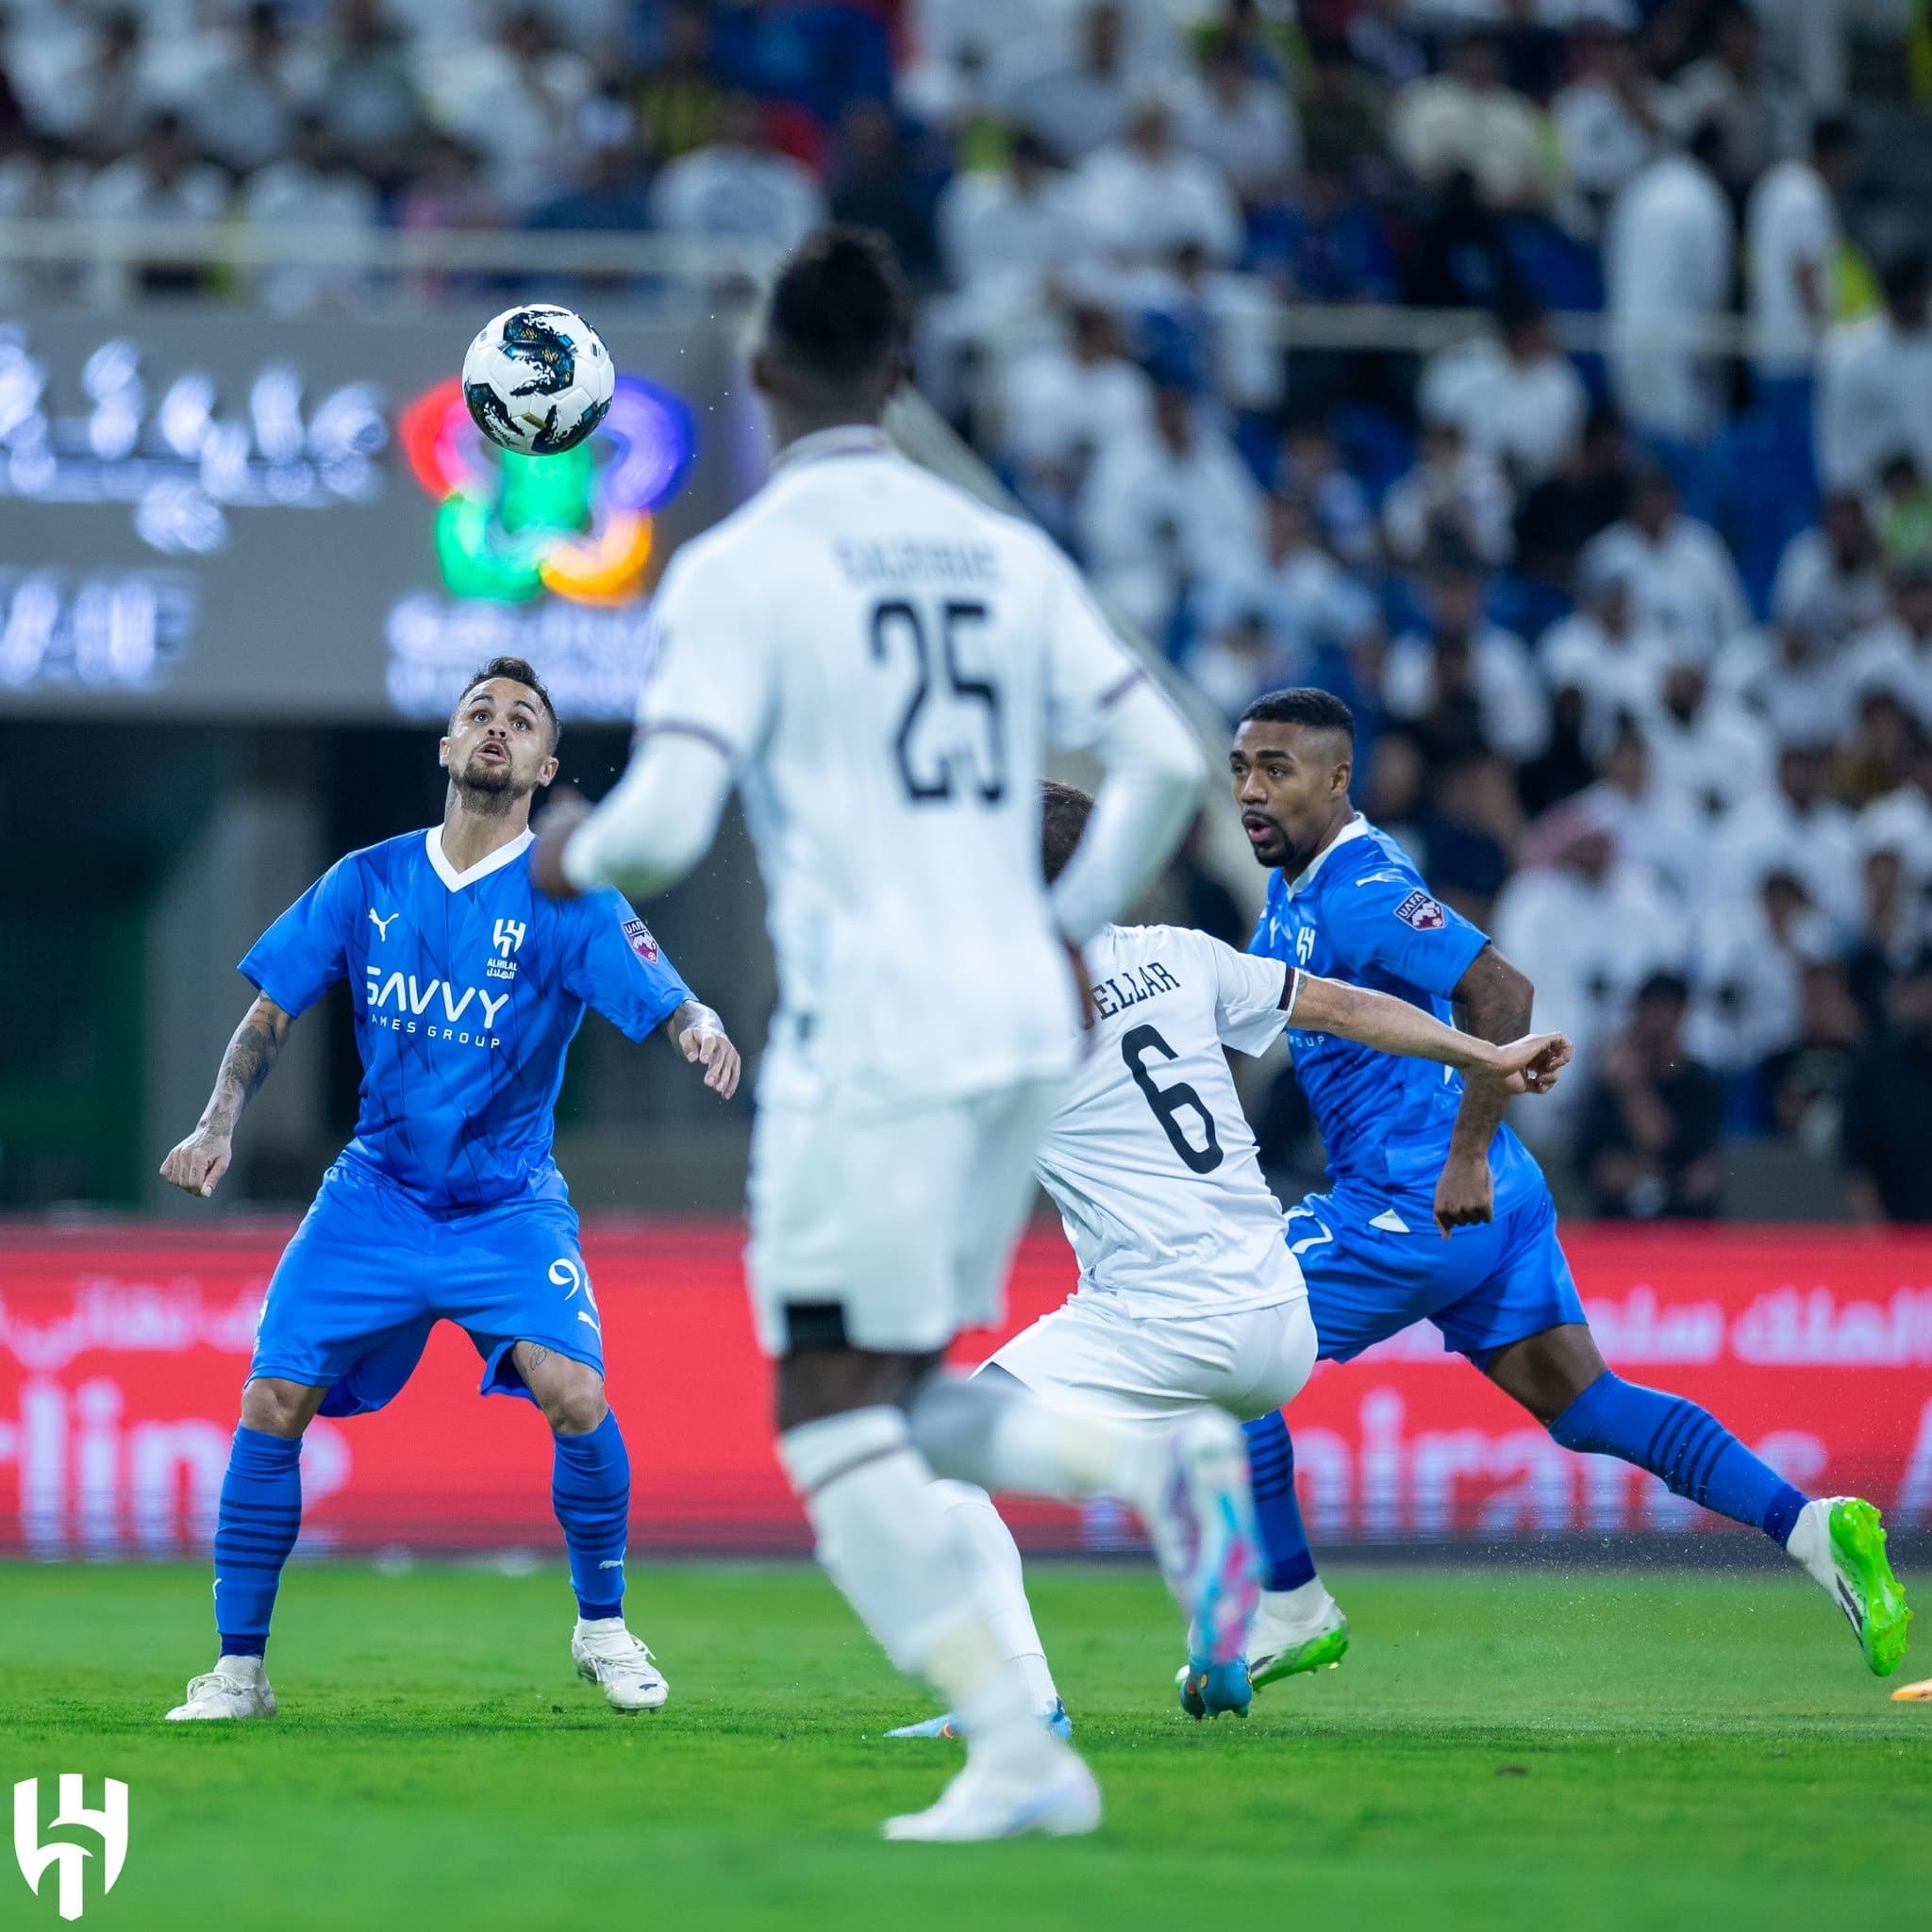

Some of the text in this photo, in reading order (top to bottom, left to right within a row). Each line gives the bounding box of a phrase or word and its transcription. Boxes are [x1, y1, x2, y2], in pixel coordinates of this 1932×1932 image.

[866, 600, 1004, 804] 25
[1397, 893, 1425, 917] UAFA
[366, 965, 509, 1029] SAVVY
[1091, 961, 1181, 1021] ELLAR
[372, 1013, 500, 1049] AMES GROUP
[1122, 1024, 1224, 1174] 6
